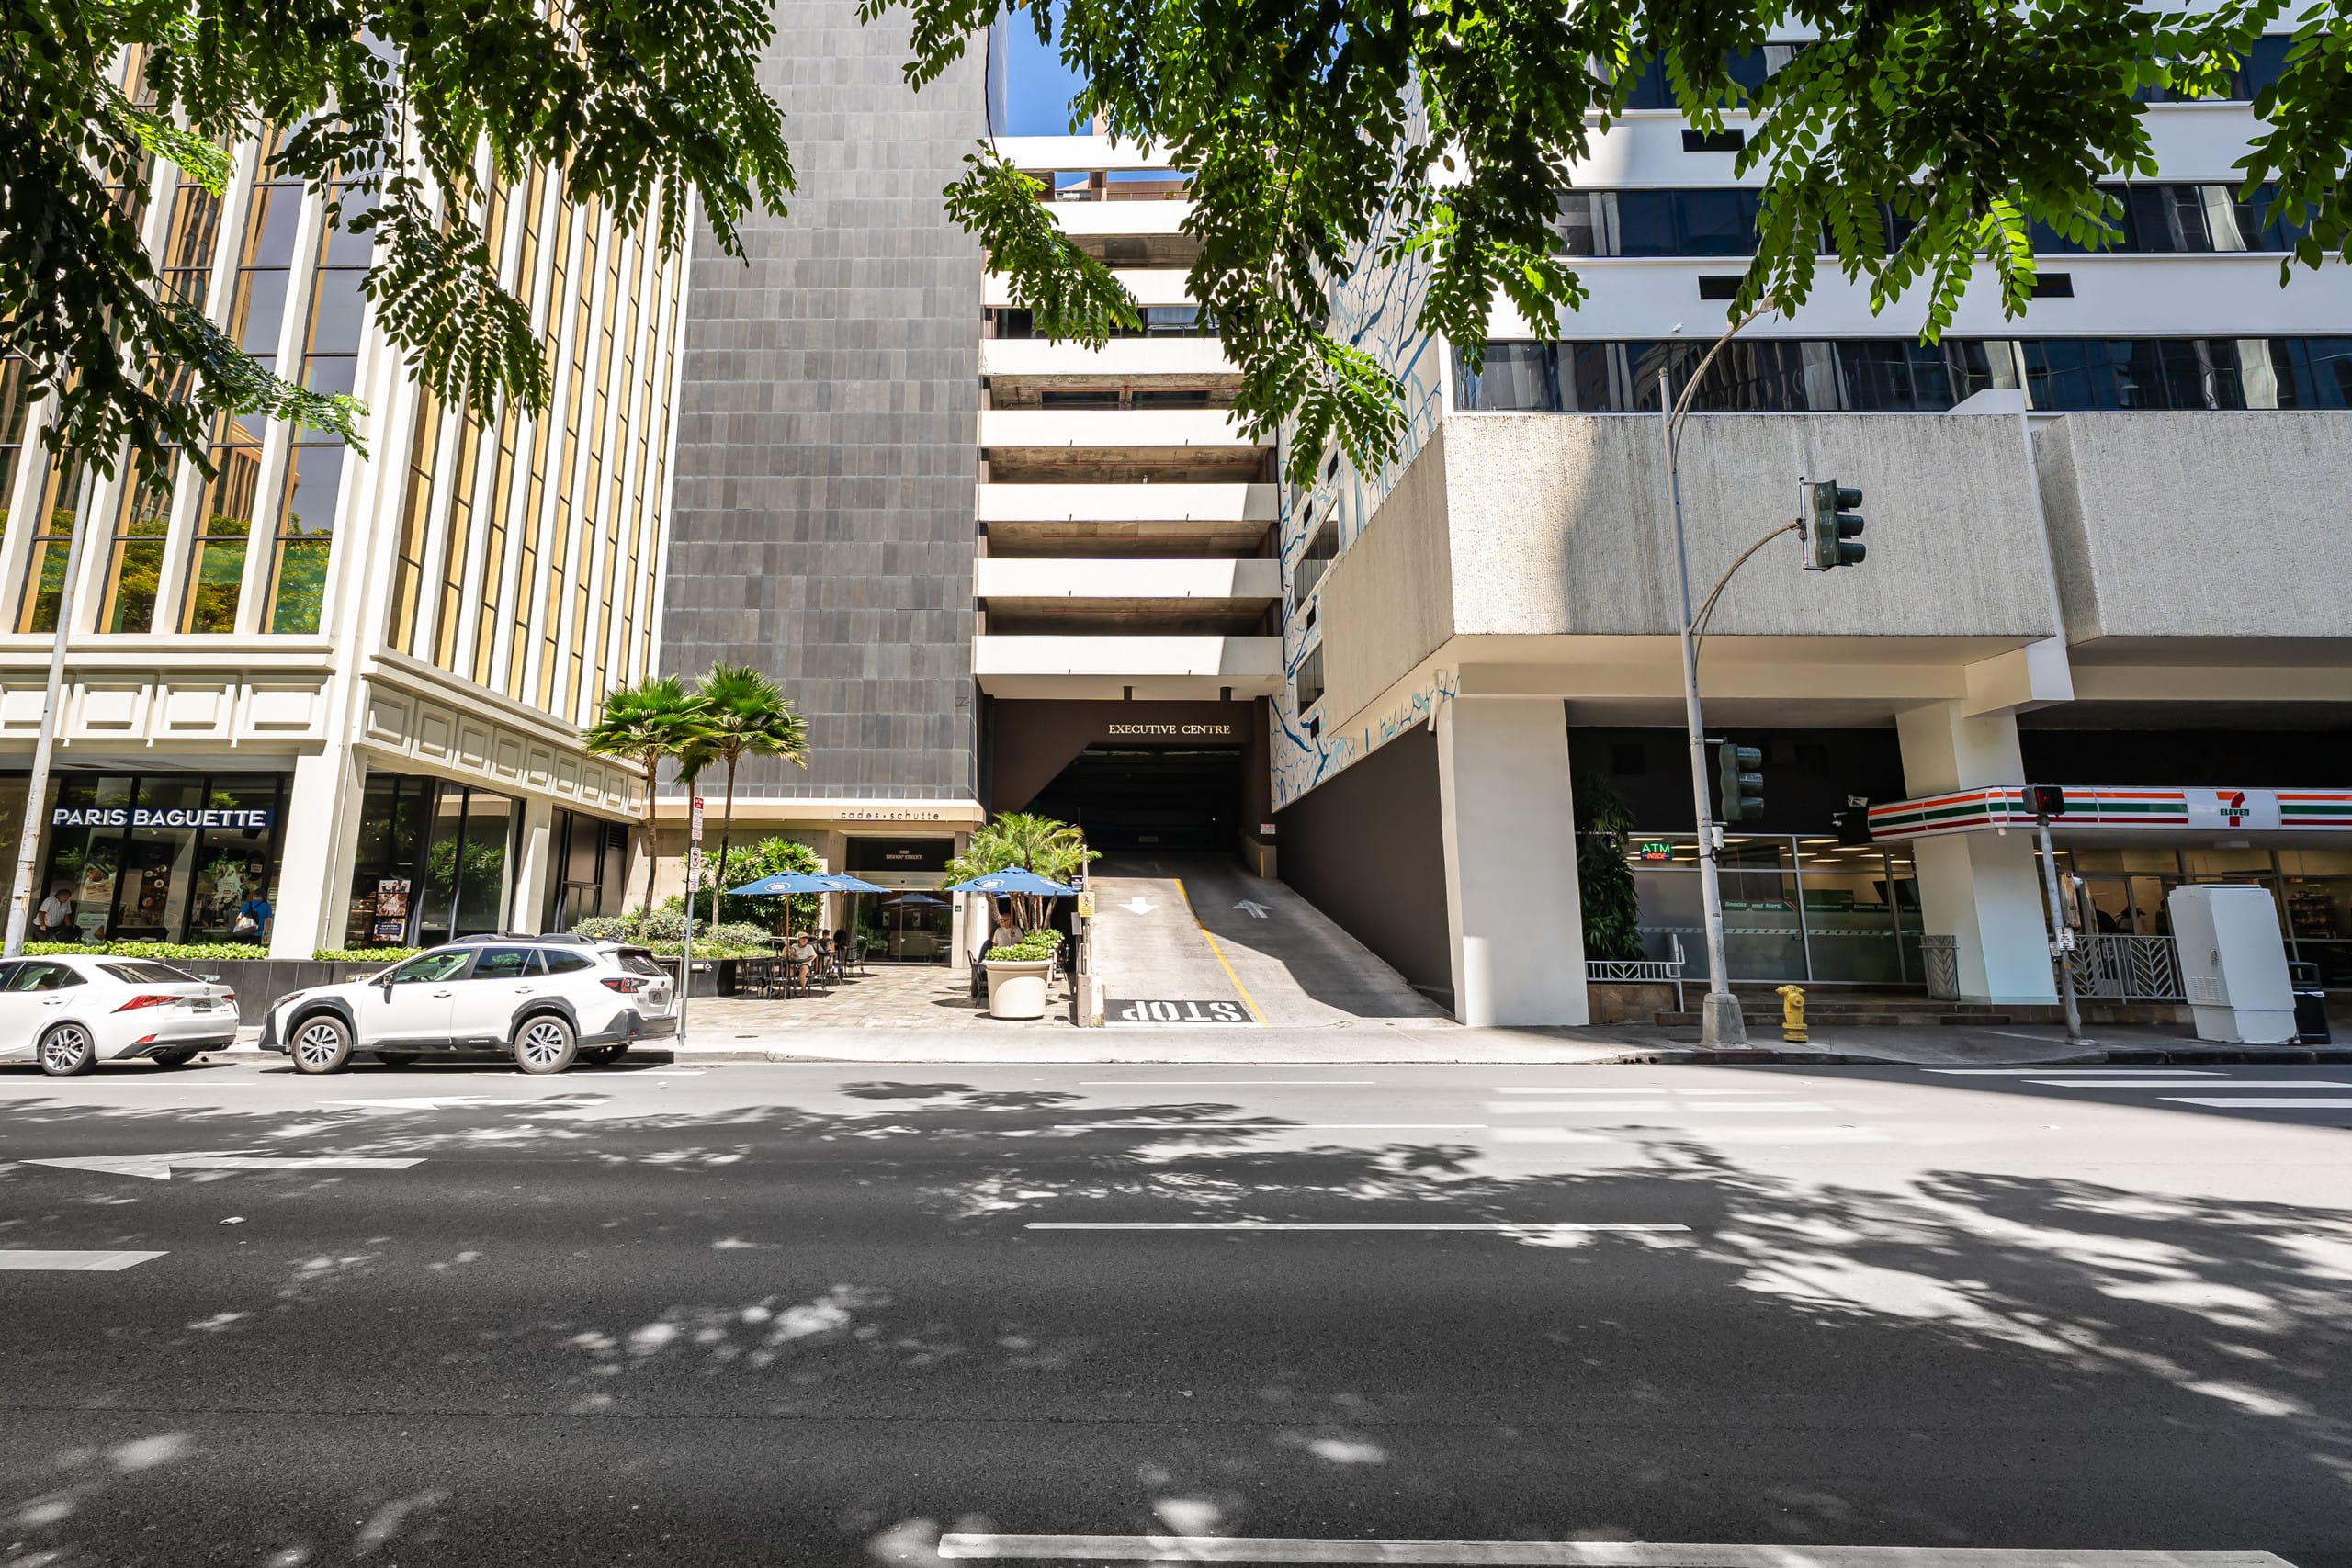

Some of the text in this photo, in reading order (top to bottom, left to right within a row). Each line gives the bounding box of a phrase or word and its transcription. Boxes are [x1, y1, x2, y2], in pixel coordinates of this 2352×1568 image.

[1109, 724, 1231, 734] EXECUTIVE CENTRE
[841, 808, 939, 820] cades schutte
[2215, 791, 2245, 827] 7
[52, 808, 266, 827] PARIS BAGUETTE
[1641, 843, 1670, 852] ATM
[1121, 1001, 1242, 1021] STOP
